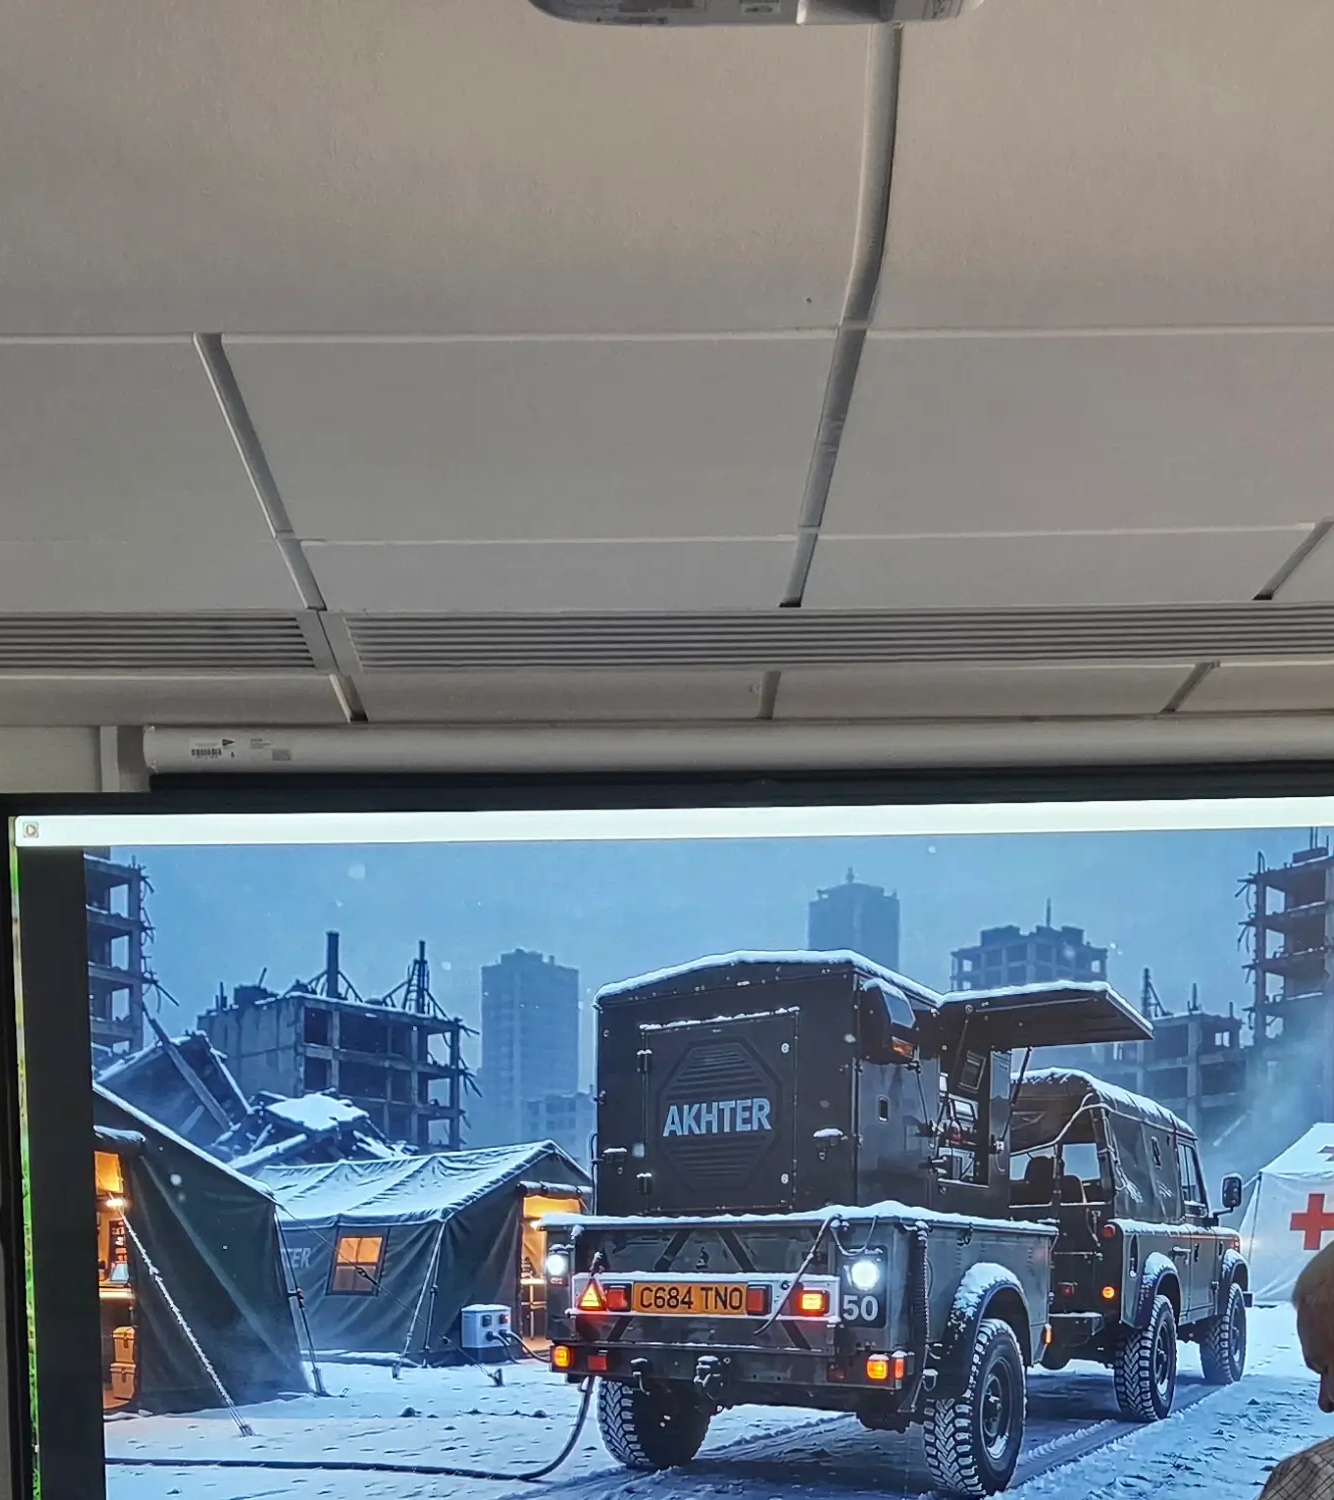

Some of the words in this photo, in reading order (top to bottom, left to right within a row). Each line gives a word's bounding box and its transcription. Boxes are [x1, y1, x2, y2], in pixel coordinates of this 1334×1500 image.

[663, 1098, 772, 1137] AKHTER
[640, 1286, 694, 1310] C684
[700, 1286, 744, 1311] TNO
[842, 1294, 879, 1321] 50
